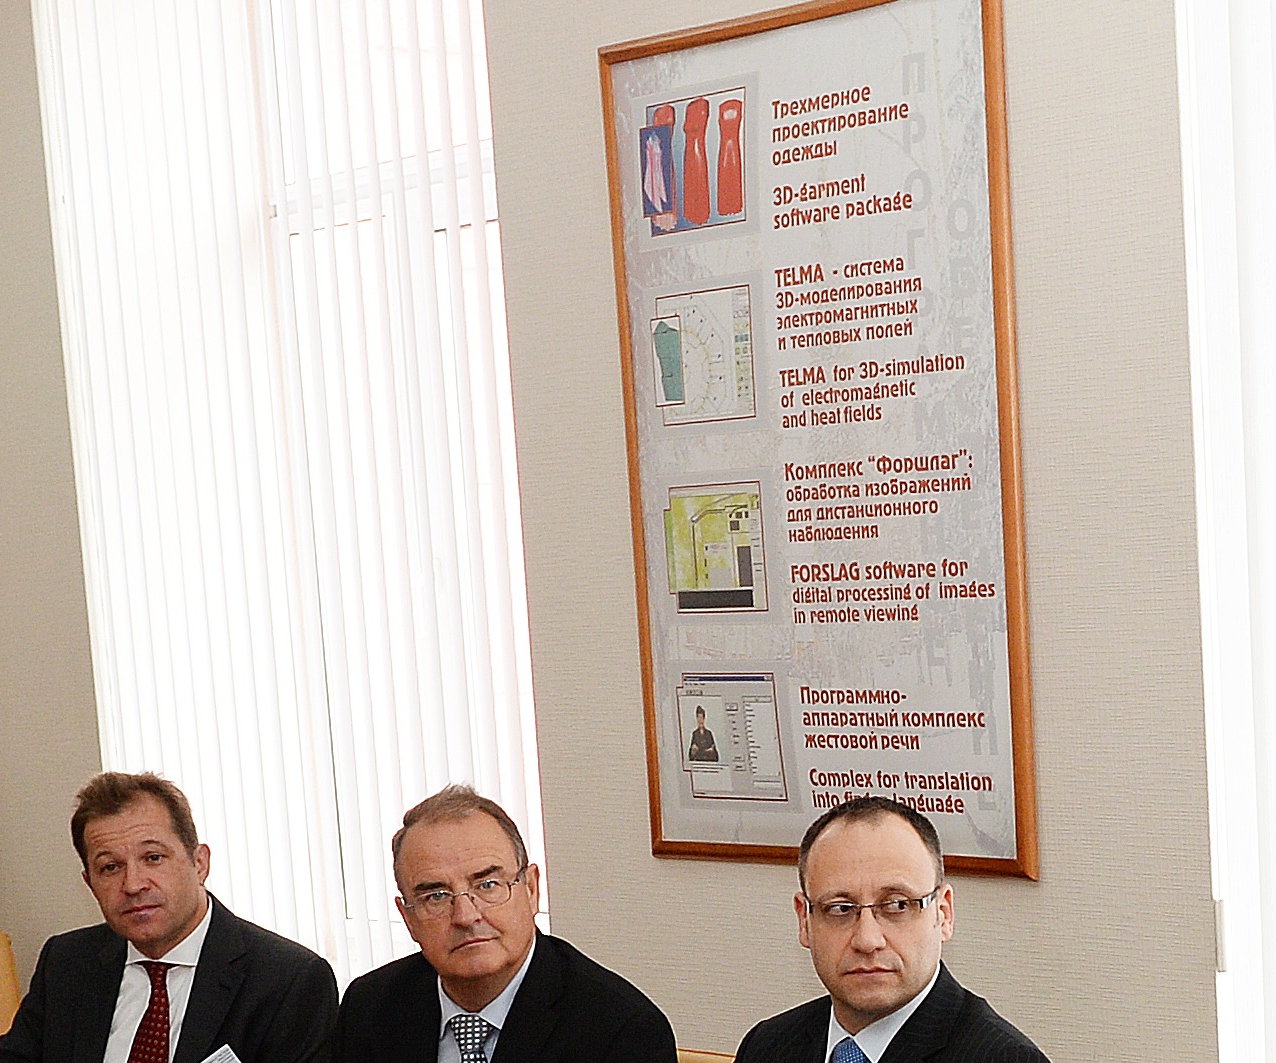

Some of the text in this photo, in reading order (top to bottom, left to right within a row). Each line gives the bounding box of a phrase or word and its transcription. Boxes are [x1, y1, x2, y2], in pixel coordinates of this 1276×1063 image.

[772, 86, 871, 118] Трехмерное
[772, 103, 909, 141] проектирование
[772, 139, 838, 166] одежды
[773, 173, 866, 207] 3D-garment
[773, 192, 913, 229] software package
[774, 264, 825, 287] TELMA
[843, 257, 905, 278] система
[777, 277, 922, 309] 3D-моделирования
[777, 299, 918, 330] электромагнитных
[778, 321, 913, 350] и тепловых полей
[780, 353, 966, 387] TELMA for 3D-simulation
[781, 380, 917, 408] of electromagnetic
[782, 404, 882, 429] and heat fields
[784, 461, 864, 481] Комплекс
[786, 473, 972, 503] обработка изображений
[787, 499, 939, 523] для дистанционного
[788, 524, 879, 543] наблюдения
[791, 559, 969, 583] FORSLAG software for
[793, 581, 996, 604] digital processing of images
[794, 604, 919, 623] in remote viewing
[800, 685, 907, 705] Программно-
[803, 706, 986, 728] аппаратный комплекс
[805, 729, 920, 750] жестовой речи
[809, 768, 993, 791] Complex for translation
[812, 790, 841, 809] into
